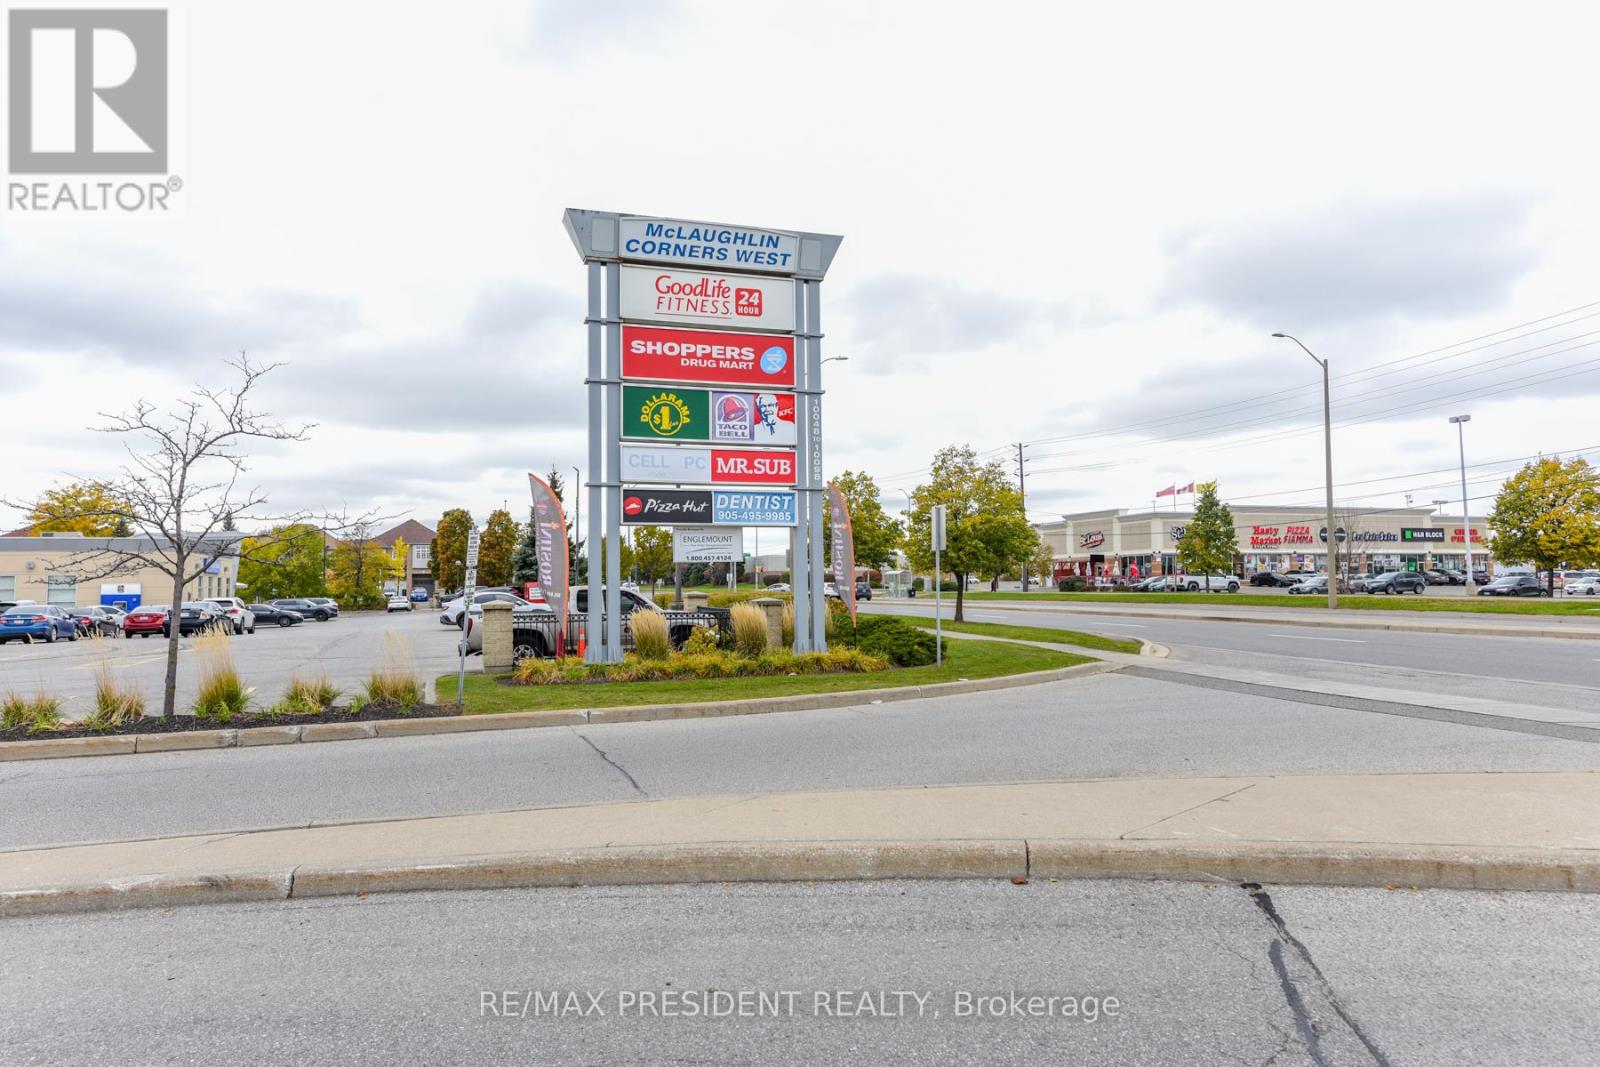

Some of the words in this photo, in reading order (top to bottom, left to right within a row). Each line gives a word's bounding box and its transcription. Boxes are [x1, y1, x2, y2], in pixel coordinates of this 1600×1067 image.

[645, 223, 780, 249] McLAUGHLIN
[625, 239, 728, 261] CORNERS
[736, 249, 791, 266] WEST
[655, 275, 731, 299] GoodLife
[656, 296, 730, 315] FITNESS
[738, 291, 760, 306] 24
[738, 305, 760, 315] HOUR
[630, 339, 755, 361] SHOPPERS
[680, 358, 716, 368] DRUG
[719, 361, 754, 370] MART
[640, 392, 690, 423] DOLLARAMA
[778, 407, 793, 417] KFC
[717, 423, 748, 431] TACO
[718, 430, 748, 438] BELL
[628, 453, 671, 469] CELL
[683, 455, 706, 470] PC
[716, 457, 792, 475] MR.SUB
[643, 498, 681, 513] Pizza
[682, 499, 710, 513] Hut
[717, 494, 793, 510] DENTIST
[718, 510, 791, 521] 905-495-9985
[1287, 526, 1310, 534] PIZZA
[683, 535, 733, 544] ENGLEMOUNT
[1283, 535, 1313, 544] FIAMMA
